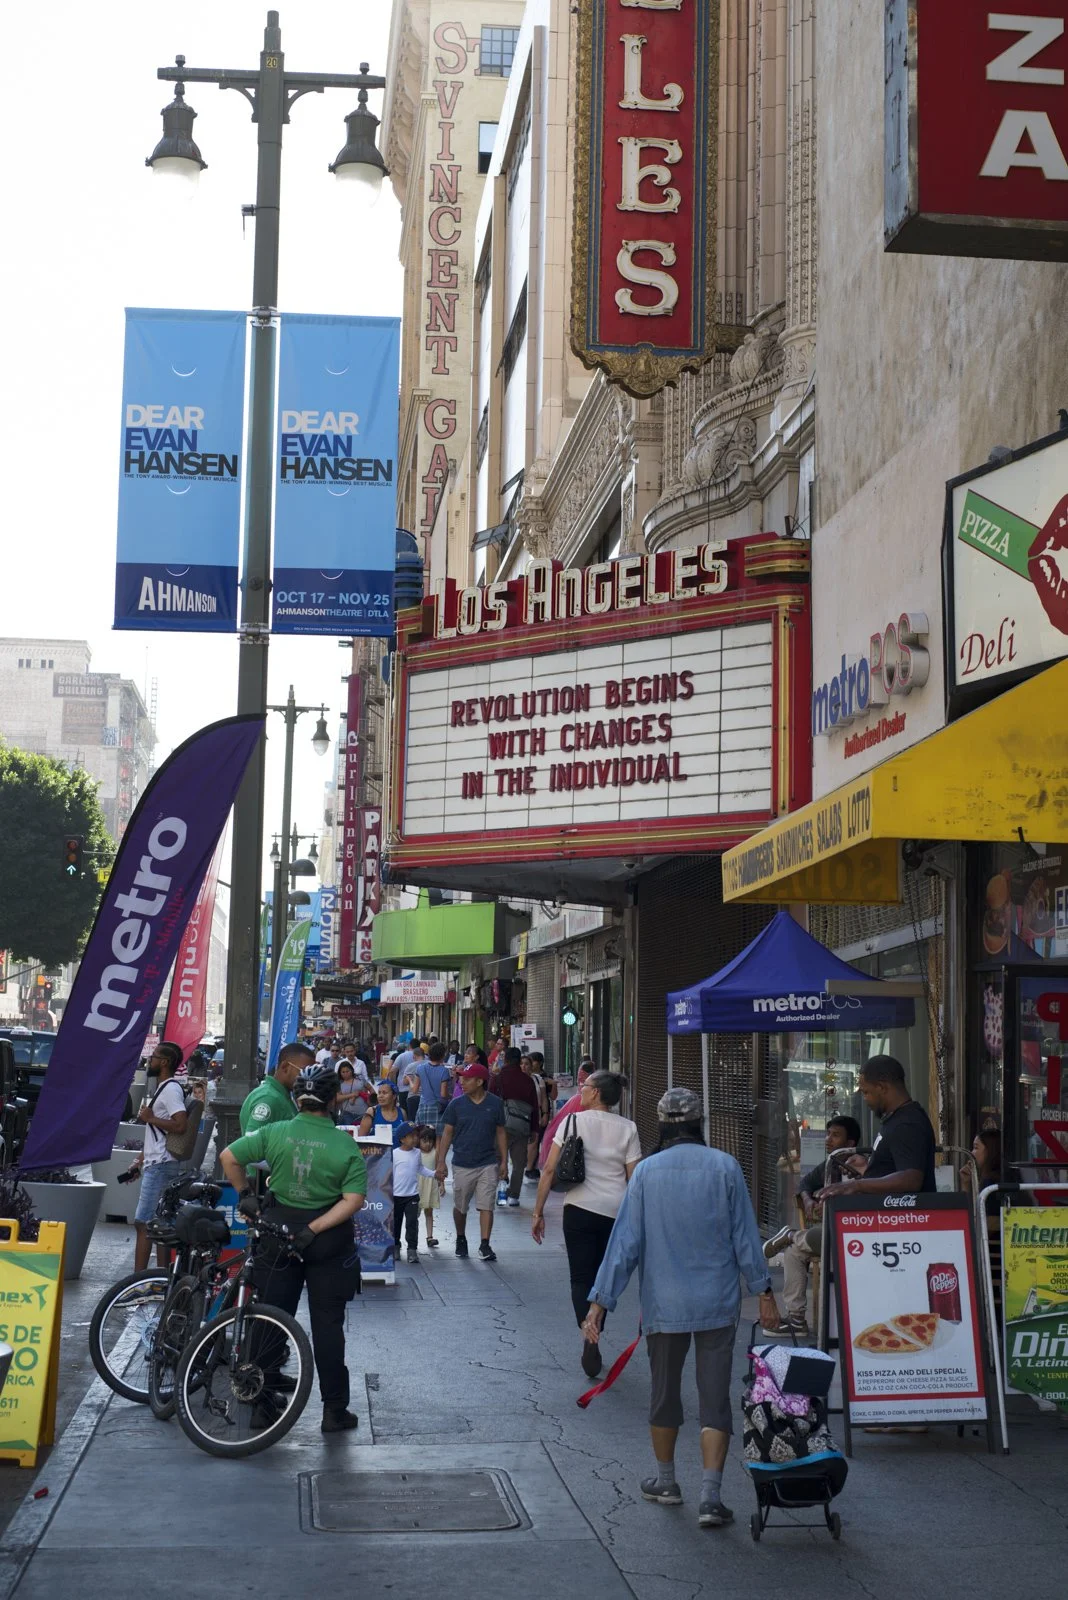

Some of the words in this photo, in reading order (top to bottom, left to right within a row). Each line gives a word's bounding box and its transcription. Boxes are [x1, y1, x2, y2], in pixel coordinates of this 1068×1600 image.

[266, 57, 277, 67] 20
[614, 0, 684, 316] LES
[425, 80, 464, 376] VINCENT
[126, 403, 205, 430] DEAR
[281, 410, 359, 435] DEAR
[125, 426, 198, 452] EVAN
[281, 433, 353, 458] EVAN
[124, 450, 238, 477] HANSEN
[280, 456, 393, 482] HANSEN
[961, 509, 1010, 558] PIZZA
[137, 575, 218, 613] AHMANSON
[276, 591, 307, 604] OCT
[311, 592, 325, 604] 17
[339, 593, 370, 605] NOV
[373, 594, 390, 606] 25
[434, 577, 508, 639] LOS
[524, 541, 729, 624] ANGELES
[960, 617, 1017, 677] Deli
[58, 686, 103, 696] BUILDING
[450, 683, 591, 728] REVOLUTION
[605, 669, 695, 710] BEGINS
[488, 727, 546, 760] WITH
[560, 713, 673, 752] CHANGES
[881, 711, 907, 742] Dealer
[462, 770, 483, 800] IN
[494, 766, 537, 797] THE
[549, 751, 688, 793] INDIVIDUAL
[344, 731, 359, 910] Burlington
[816, 800, 843, 853] SALADS
[847, 785, 871, 839] LOTTO
[83, 816, 188, 1035] metro
[776, 1014, 816, 1022] Authorized
[816, 1013, 840, 1021] Dealer
[841, 1213, 875, 1227] enjoy
[878, 1212, 930, 1226] together
[851, 1242, 861, 1255] 2
[13, 1325, 43, 1344] DE
[857, 1370, 873, 1378] KISS
[1011, 1358, 1022, 1367] A
